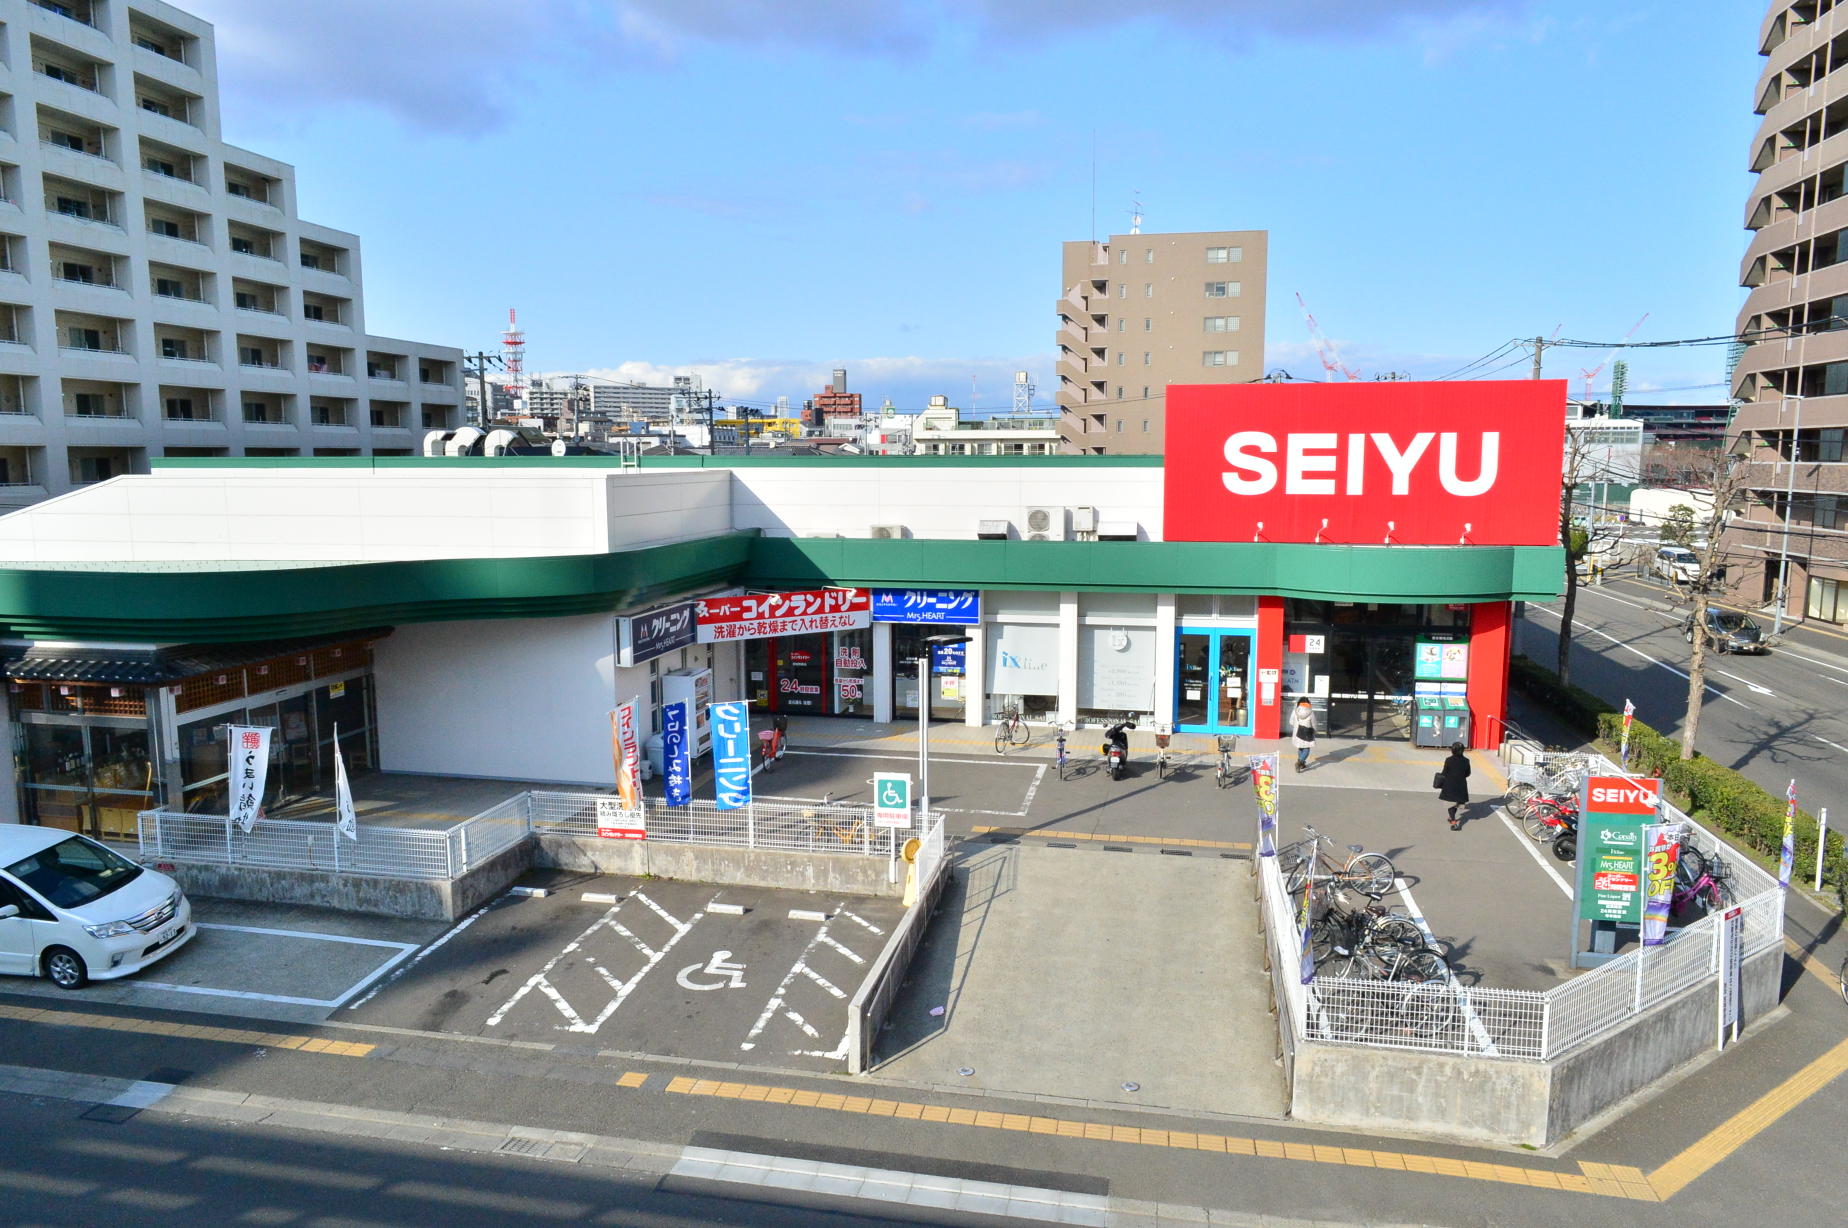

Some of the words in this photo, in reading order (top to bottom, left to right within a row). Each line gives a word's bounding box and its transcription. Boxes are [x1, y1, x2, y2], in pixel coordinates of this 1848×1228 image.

[1222, 431, 1500, 496] SEIYU
[904, 591, 975, 609] クリーニング
[651, 607, 690, 639] クリーニング
[713, 614, 856, 639] 洗濯から乾燥まで入れ替えなし
[1309, 638, 1321, 647] 24
[1591, 788, 1655, 804] SEIYU
